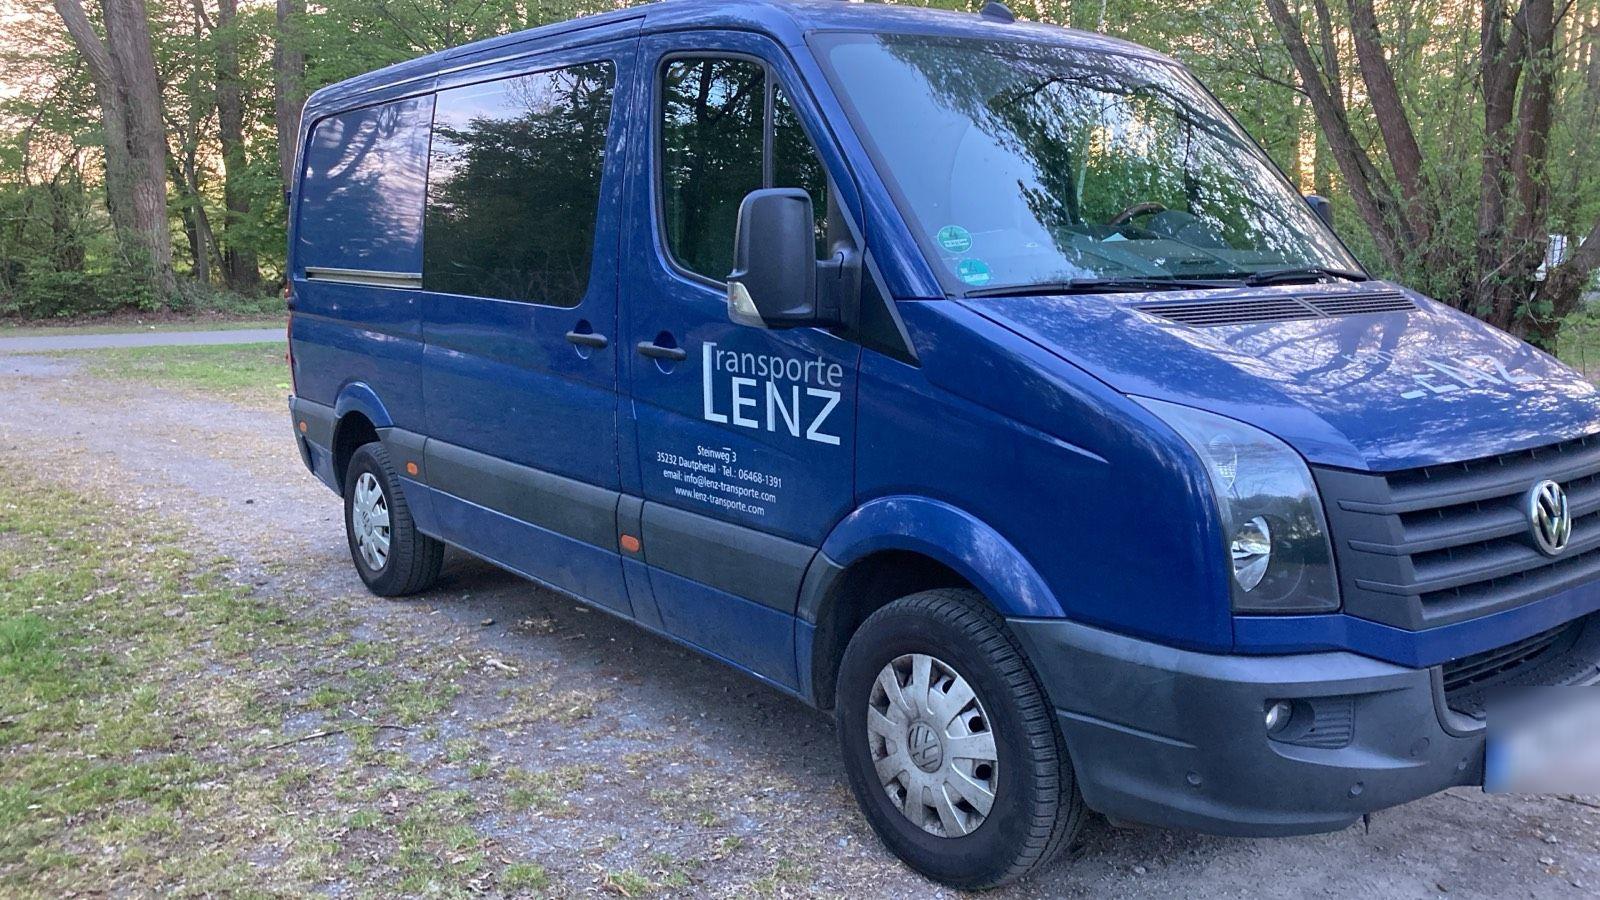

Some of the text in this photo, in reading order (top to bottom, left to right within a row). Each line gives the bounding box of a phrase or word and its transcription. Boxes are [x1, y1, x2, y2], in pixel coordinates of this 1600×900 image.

[703, 341, 843, 387] Transporte
[703, 341, 841, 445] LENZ
[656, 451, 782, 488] 35232 Dautphetal Tel.: 06468-1391
[697, 445, 737, 463] Steinweg 3
[663, 469, 776, 503] email: info@lenz-transporte.com
[674, 486, 765, 516] www.lenz-transporte.com
